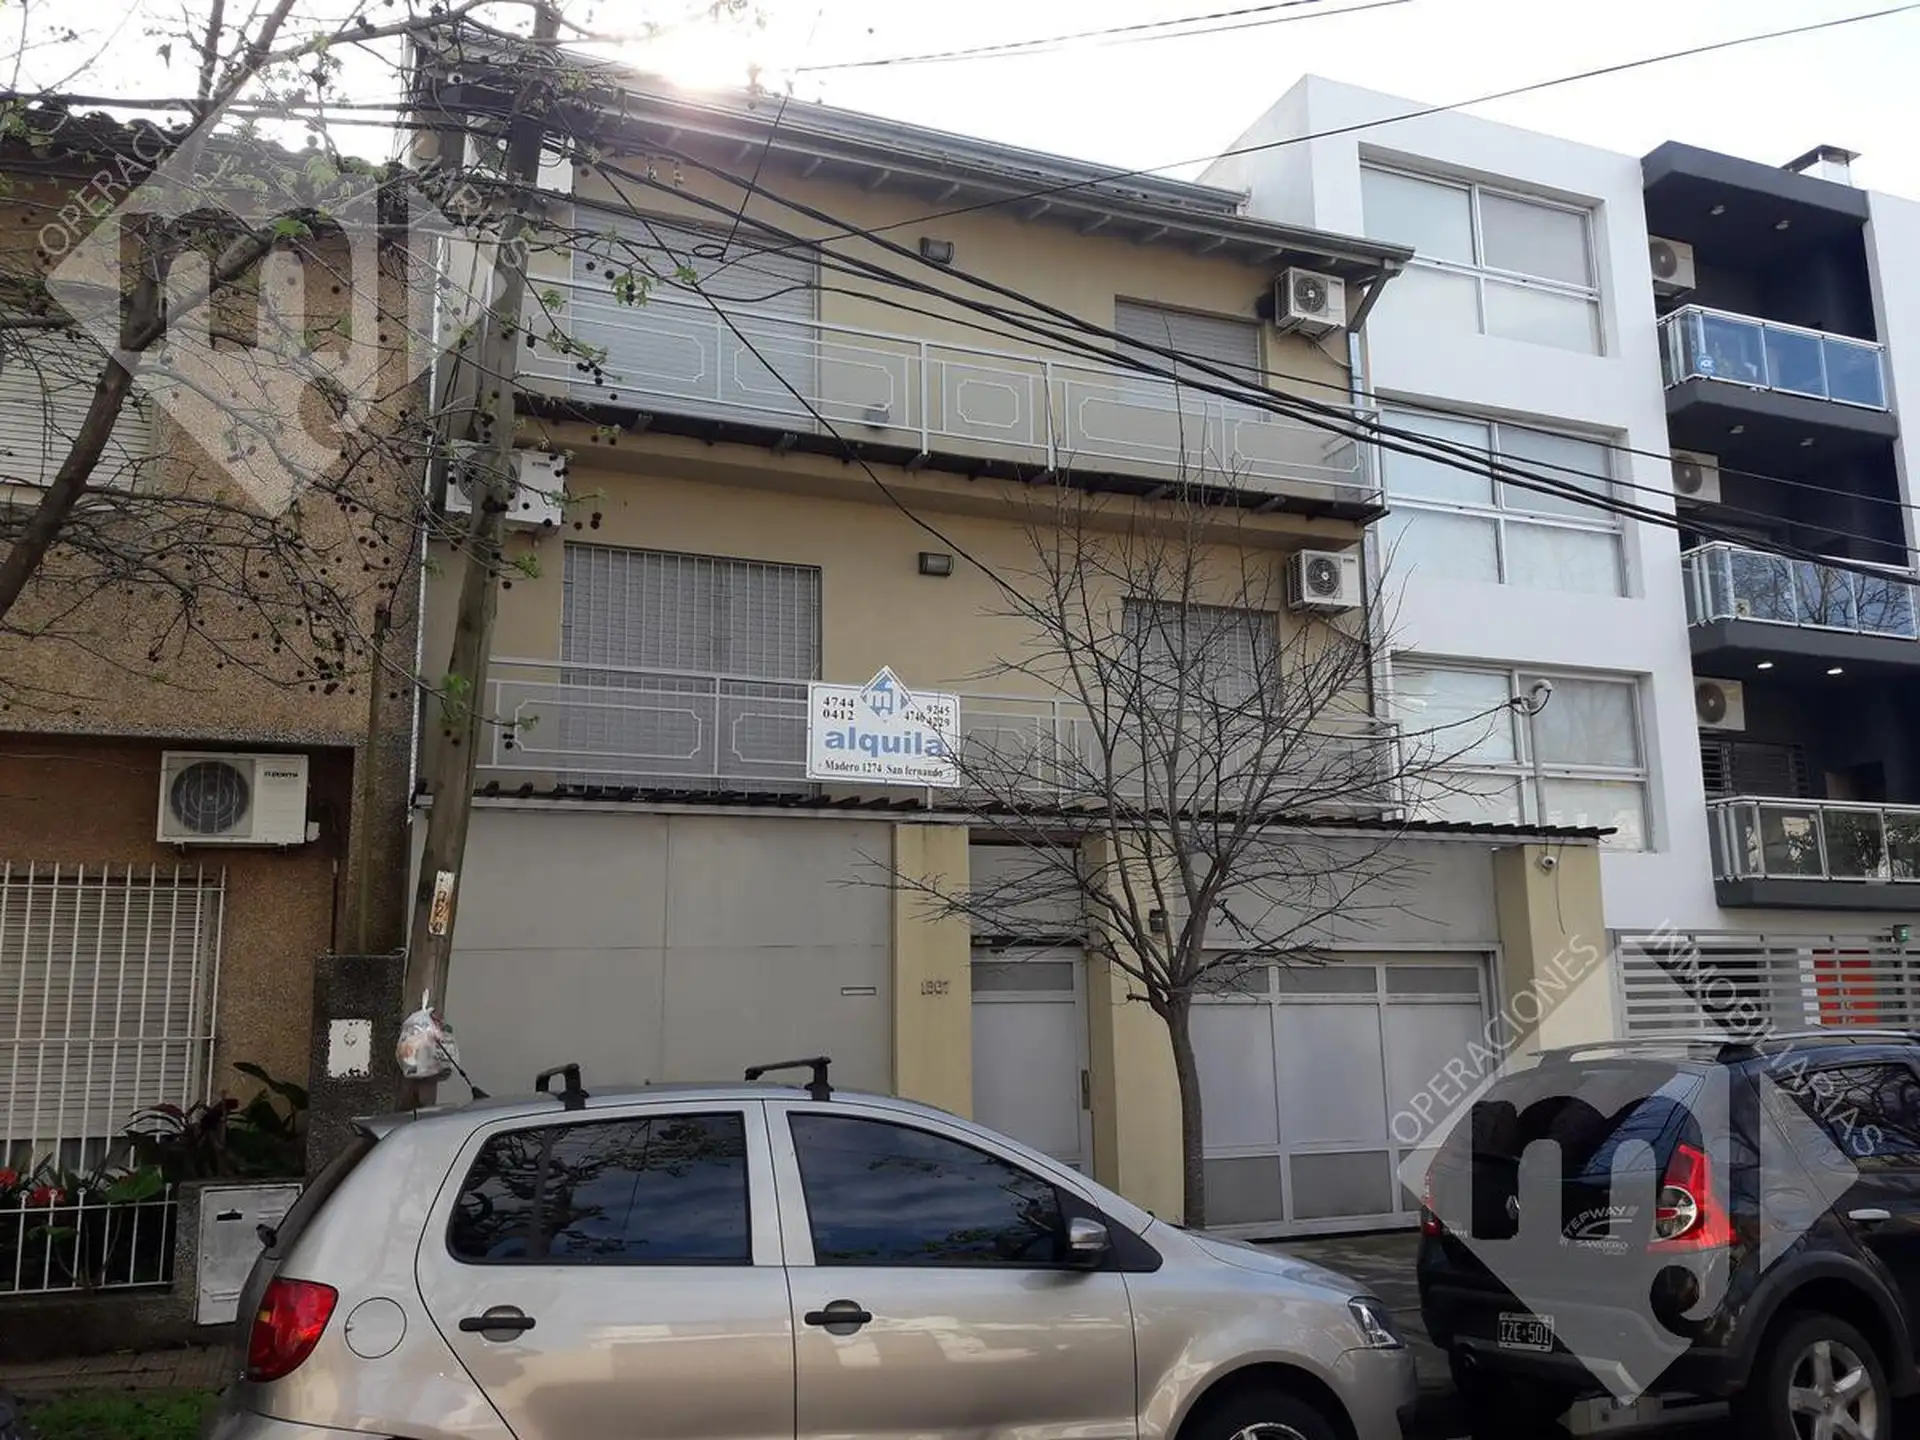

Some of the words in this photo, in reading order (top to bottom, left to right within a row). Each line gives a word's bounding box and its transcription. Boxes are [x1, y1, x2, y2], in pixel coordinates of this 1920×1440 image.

[823, 697, 854, 708] 4744
[822, 710, 854, 720] 0412
[825, 726, 945, 758] alquila
[825, 760, 860, 772] Madero
